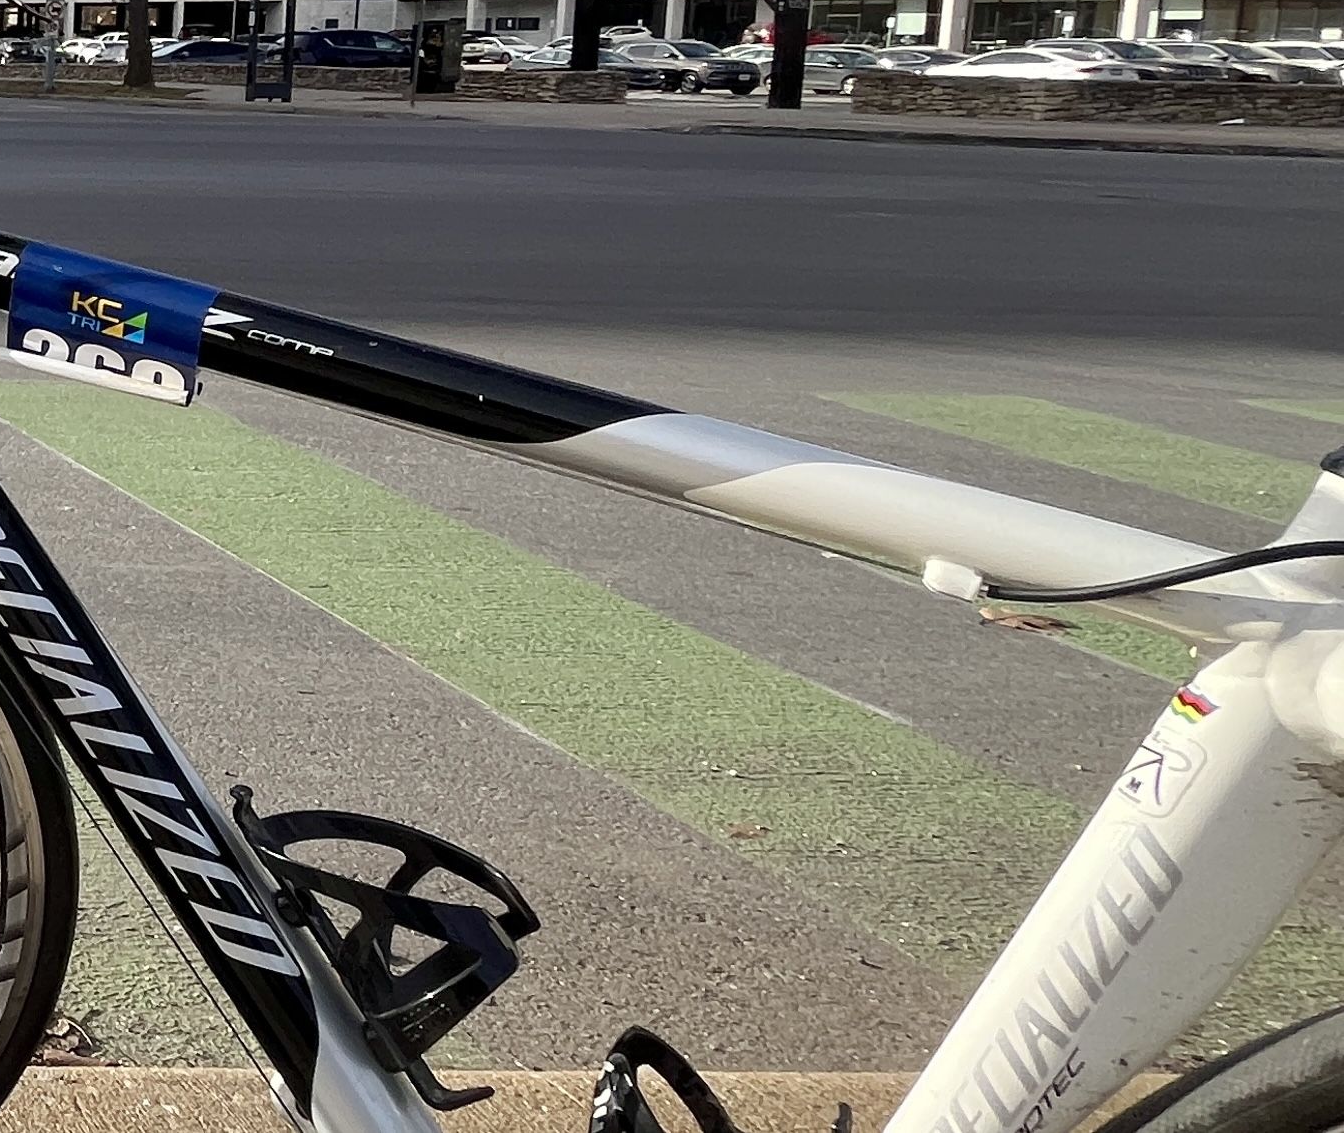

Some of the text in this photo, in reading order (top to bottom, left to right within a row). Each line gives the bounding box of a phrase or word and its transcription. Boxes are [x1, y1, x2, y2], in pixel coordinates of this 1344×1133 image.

[66, 312, 101, 332] TRI
[71, 290, 123, 324] KC
[930, 824, 1184, 1133] ECIALIZED
